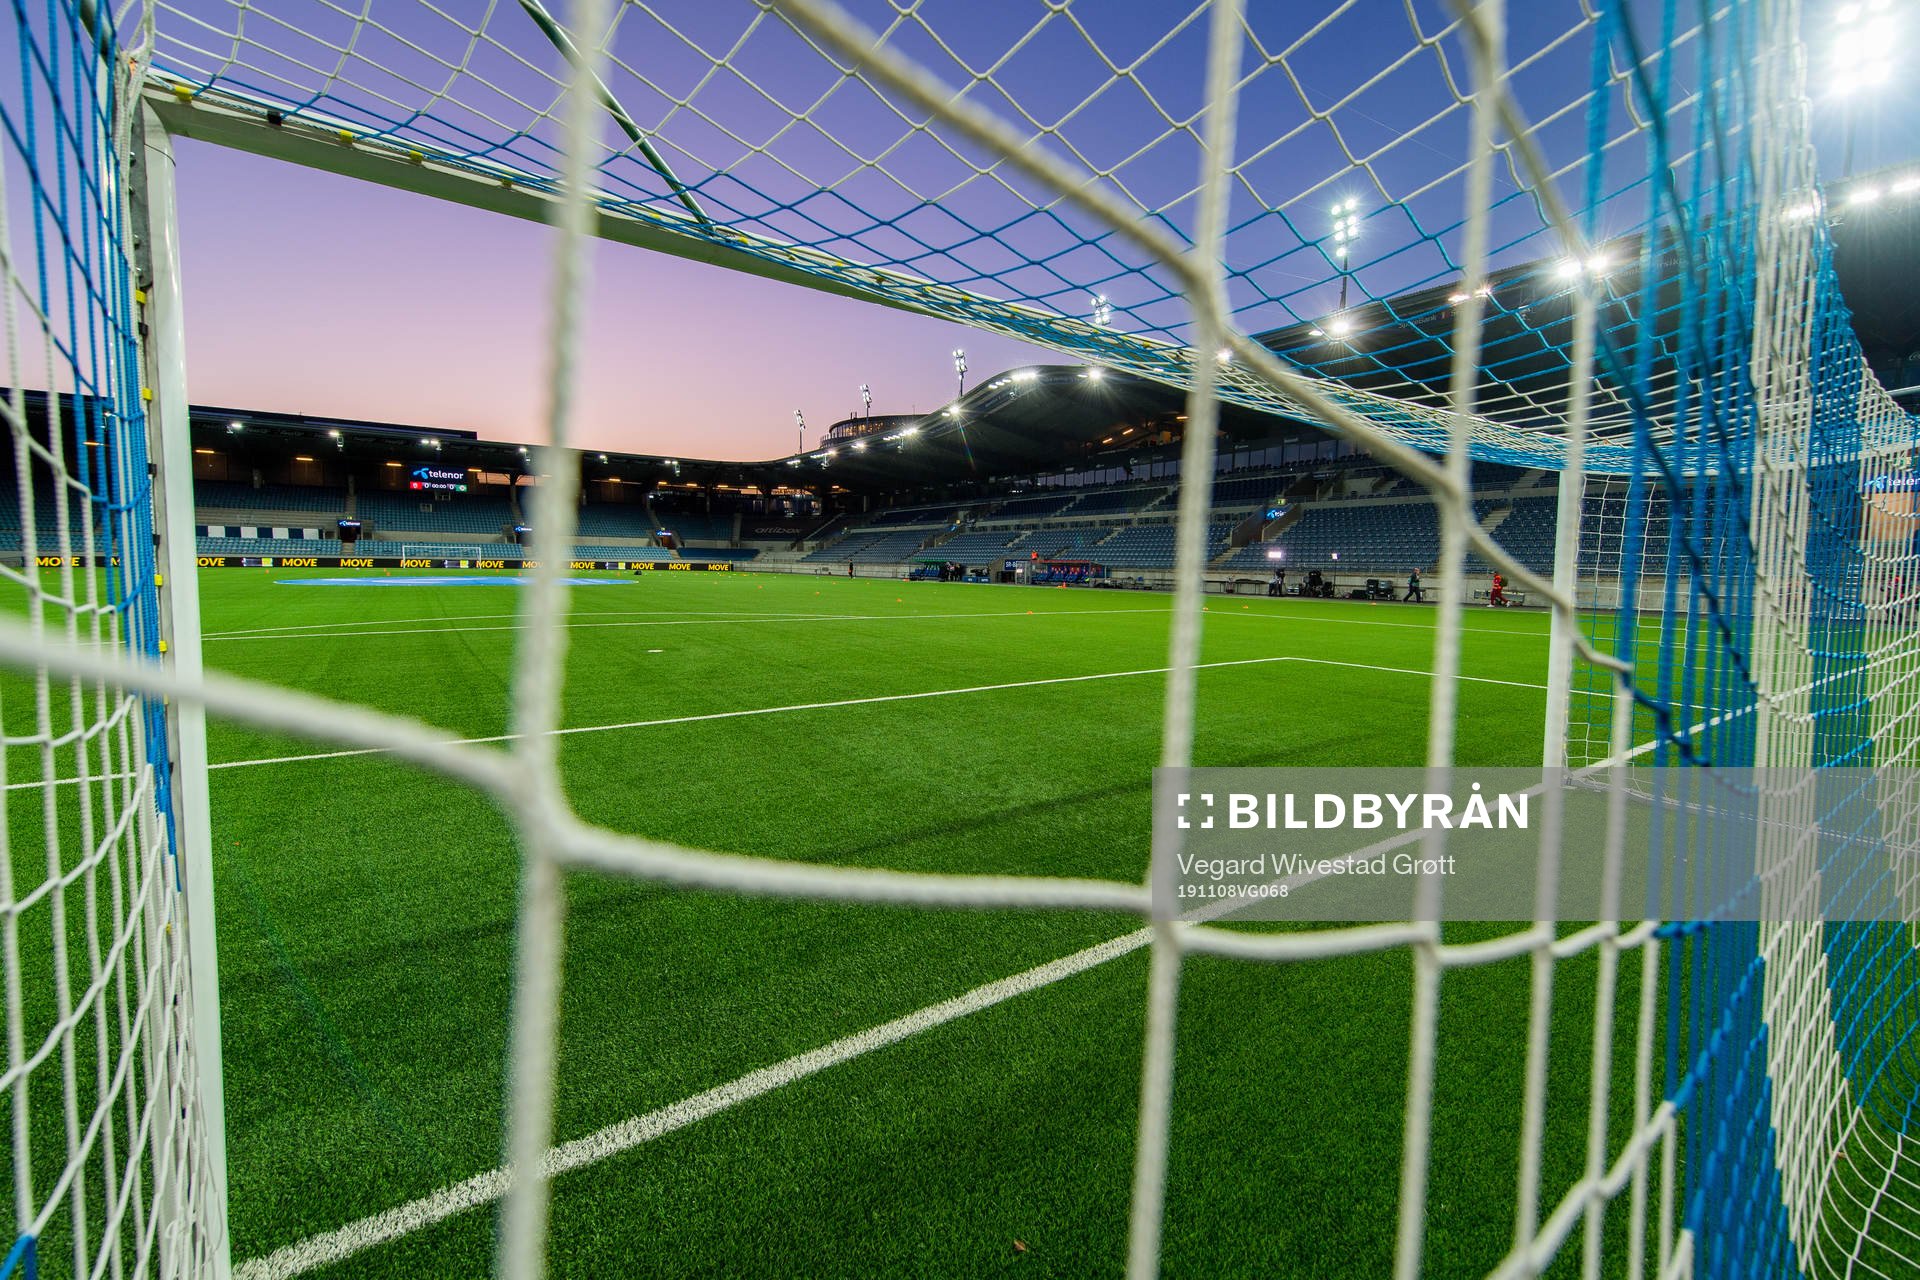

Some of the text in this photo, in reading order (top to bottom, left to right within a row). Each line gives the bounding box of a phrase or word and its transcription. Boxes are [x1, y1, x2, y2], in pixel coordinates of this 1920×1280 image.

[428, 470, 464, 479] telenor
[196, 557, 225, 567] OVE
[282, 558, 318, 567] MOVE
[340, 558, 374, 568] MOVE
[400, 560, 431, 568] MOVE
[476, 560, 504, 569] MOVE
[570, 561, 596, 570] MOVE
[631, 562, 655, 570] MOVE
[669, 563, 692, 571] MOVE
[708, 563, 729, 572] MOVE
